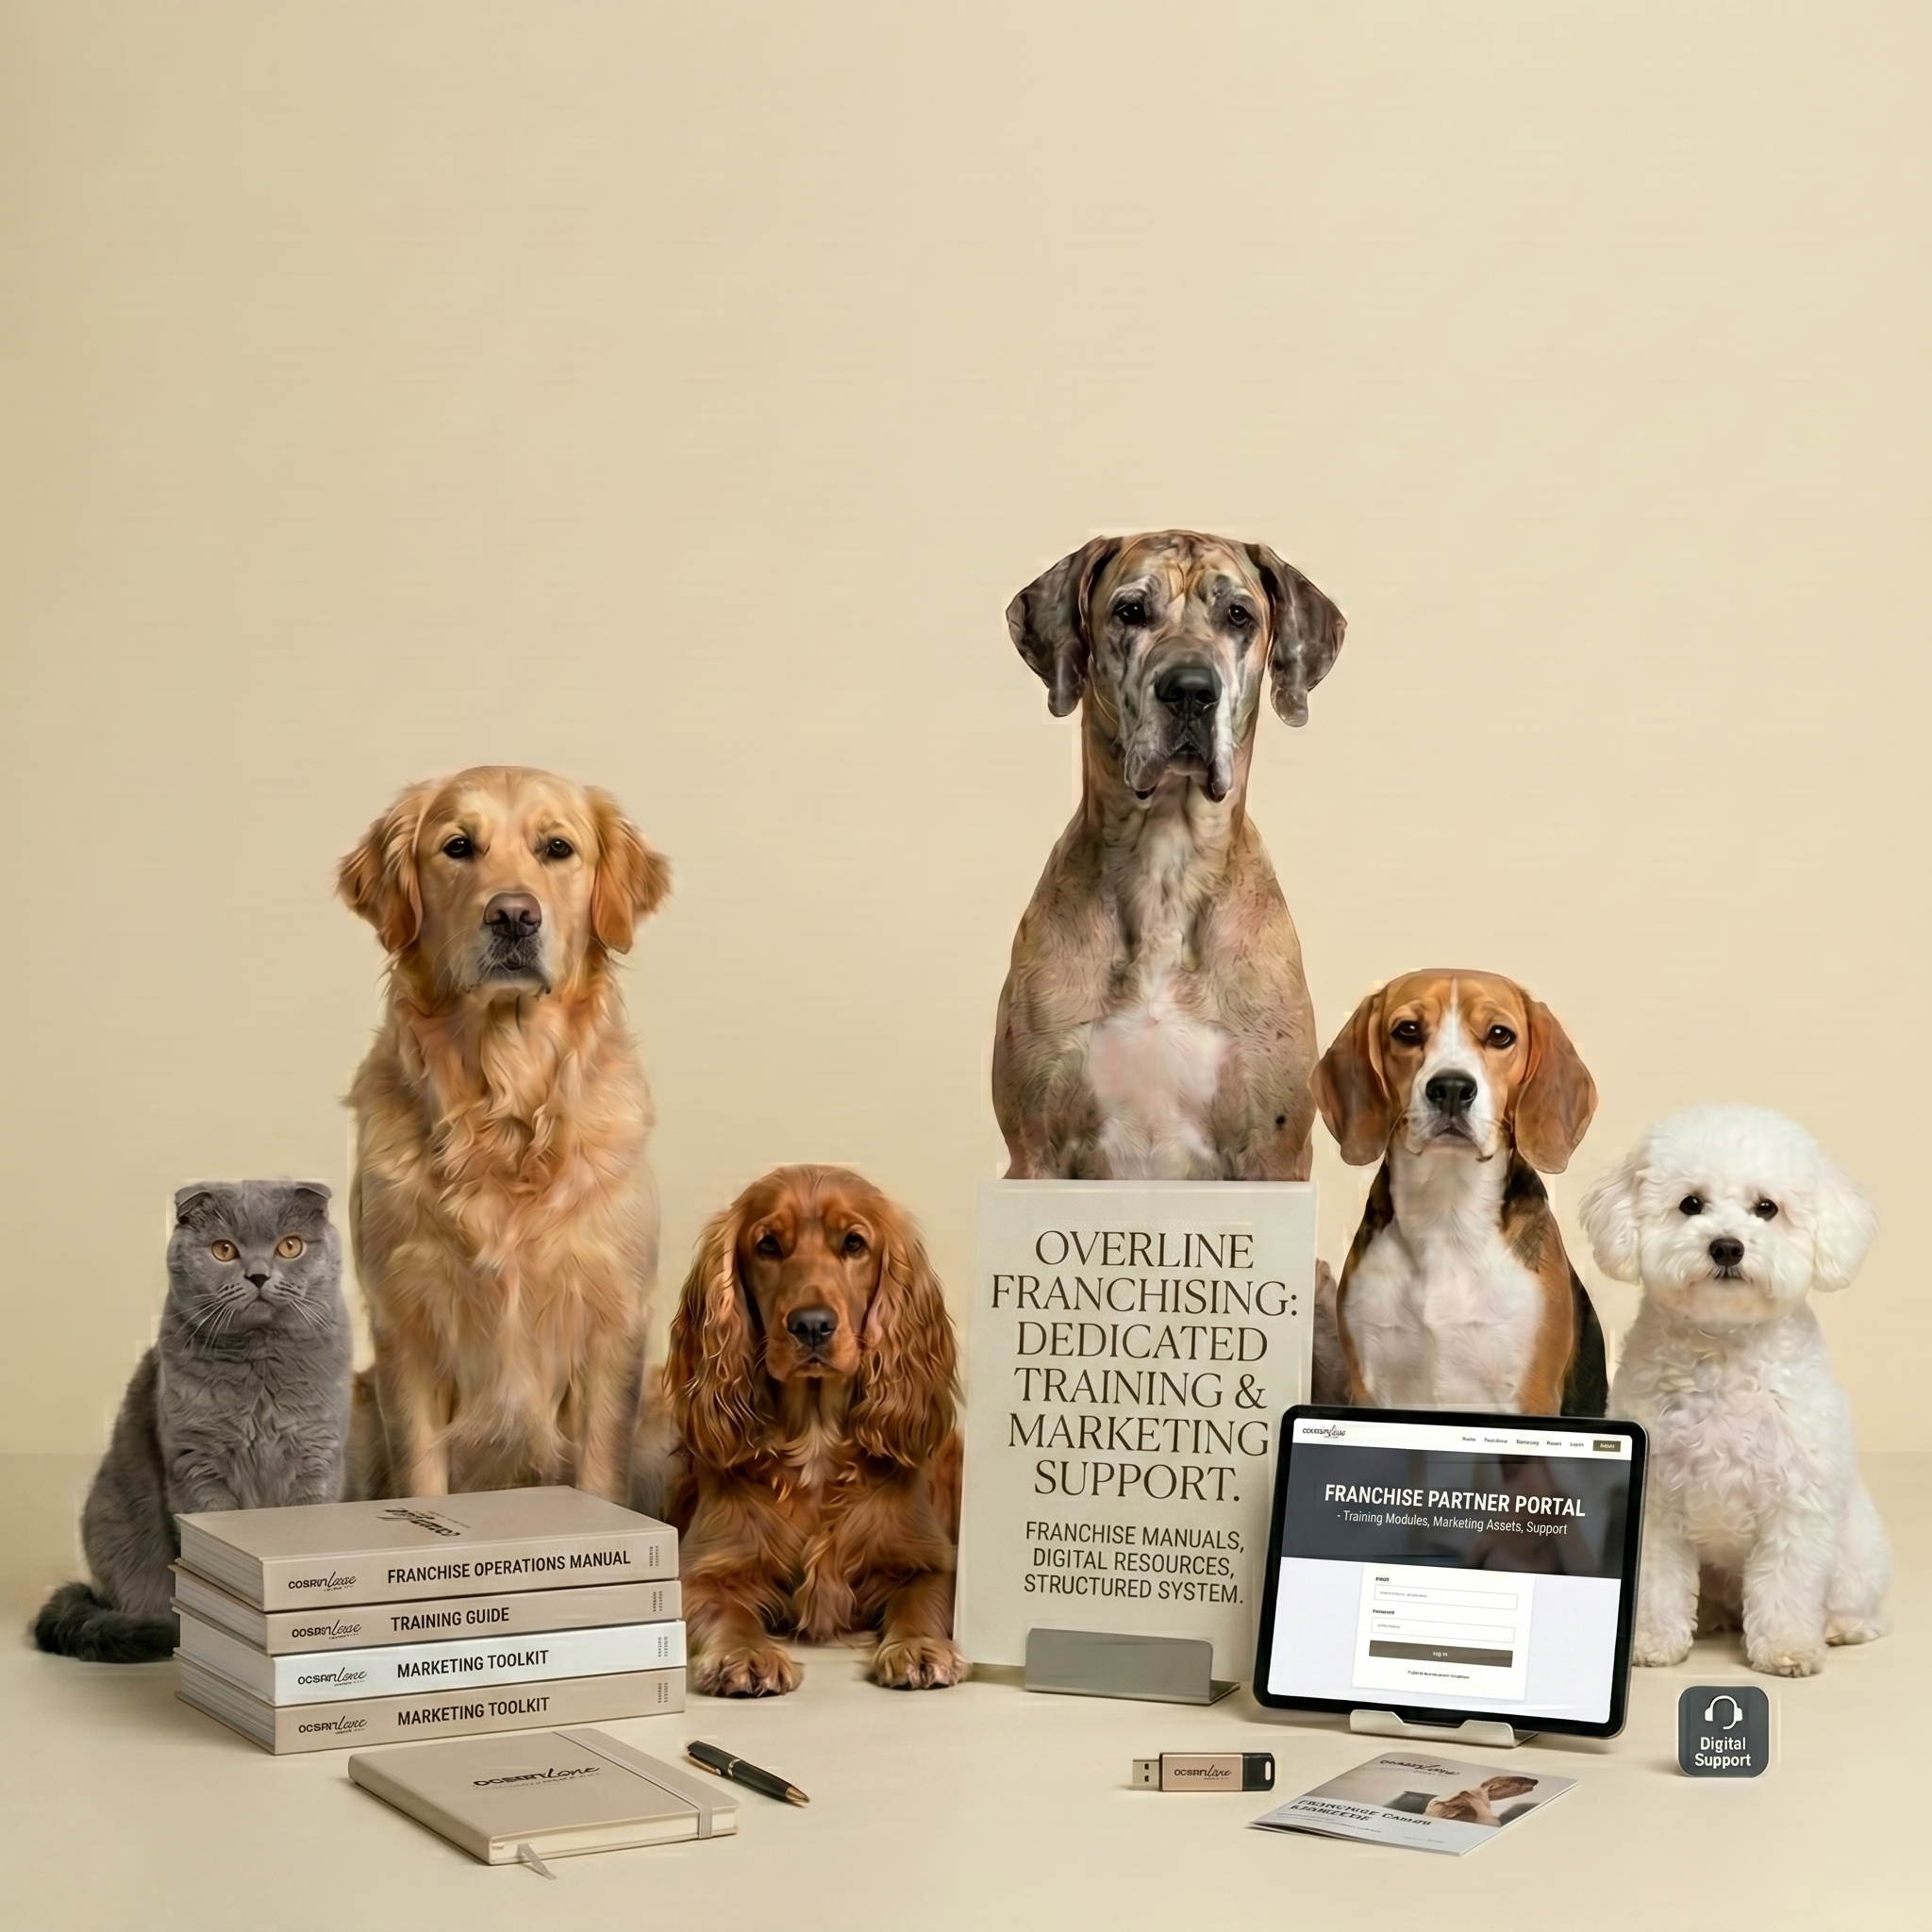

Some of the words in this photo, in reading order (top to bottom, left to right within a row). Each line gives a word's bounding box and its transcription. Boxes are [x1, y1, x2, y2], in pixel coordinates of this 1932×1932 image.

[1035, 1230, 1254, 1269] OVERLINE
[991, 1274, 1298, 1317] FRANCHISING:
[1016, 1321, 1268, 1361] DEDICATED
[1013, 1367, 1223, 1407] TRAINING
[1234, 1374, 1268, 1409] &
[1008, 1412, 1269, 1457] MARKETING
[1034, 1459, 1240, 1502] SUPPORT.
[1324, 1484, 1424, 1507] FRANCHISE
[1427, 1491, 1509, 1512] PARTNER
[1515, 1495, 1586, 1517] PORTAL
[1025, 1521, 1136, 1545] FRANCHISE
[1142, 1527, 1245, 1554] MANUALS,
[1343, 1510, 1383, 1526] Training
[1385, 1513, 1430, 1528] Modules,
[1433, 1516, 1484, 1532] Marketing
[1486, 1521, 1524, 1534] Assets,
[1526, 1522, 1568, 1537] Support
[388, 1564, 470, 1583] FRANCHISE
[475, 1557, 565, 1576] OPERATIONS
[570, 1551, 631, 1569] MANUAL
[1033, 1547, 1108, 1570] DIGITAL
[1114, 1553, 1235, 1579] RESOURCES,
[1024, 1574, 1152, 1598] STRUCTURED
[1158, 1579, 1244, 1604] SYSTEM.
[391, 1612, 461, 1631] TRAINING
[466, 1607, 509, 1624] GUIDE
[397, 1657, 483, 1678] MARKETING
[488, 1650, 549, 1669] TOOLKIT
[398, 1704, 484, 1725] MARKETING
[488, 1697, 550, 1716] TOOLKIT
[1694, 1753, 1752, 1769] Support
[1700, 1737, 1746, 1753] Digital
